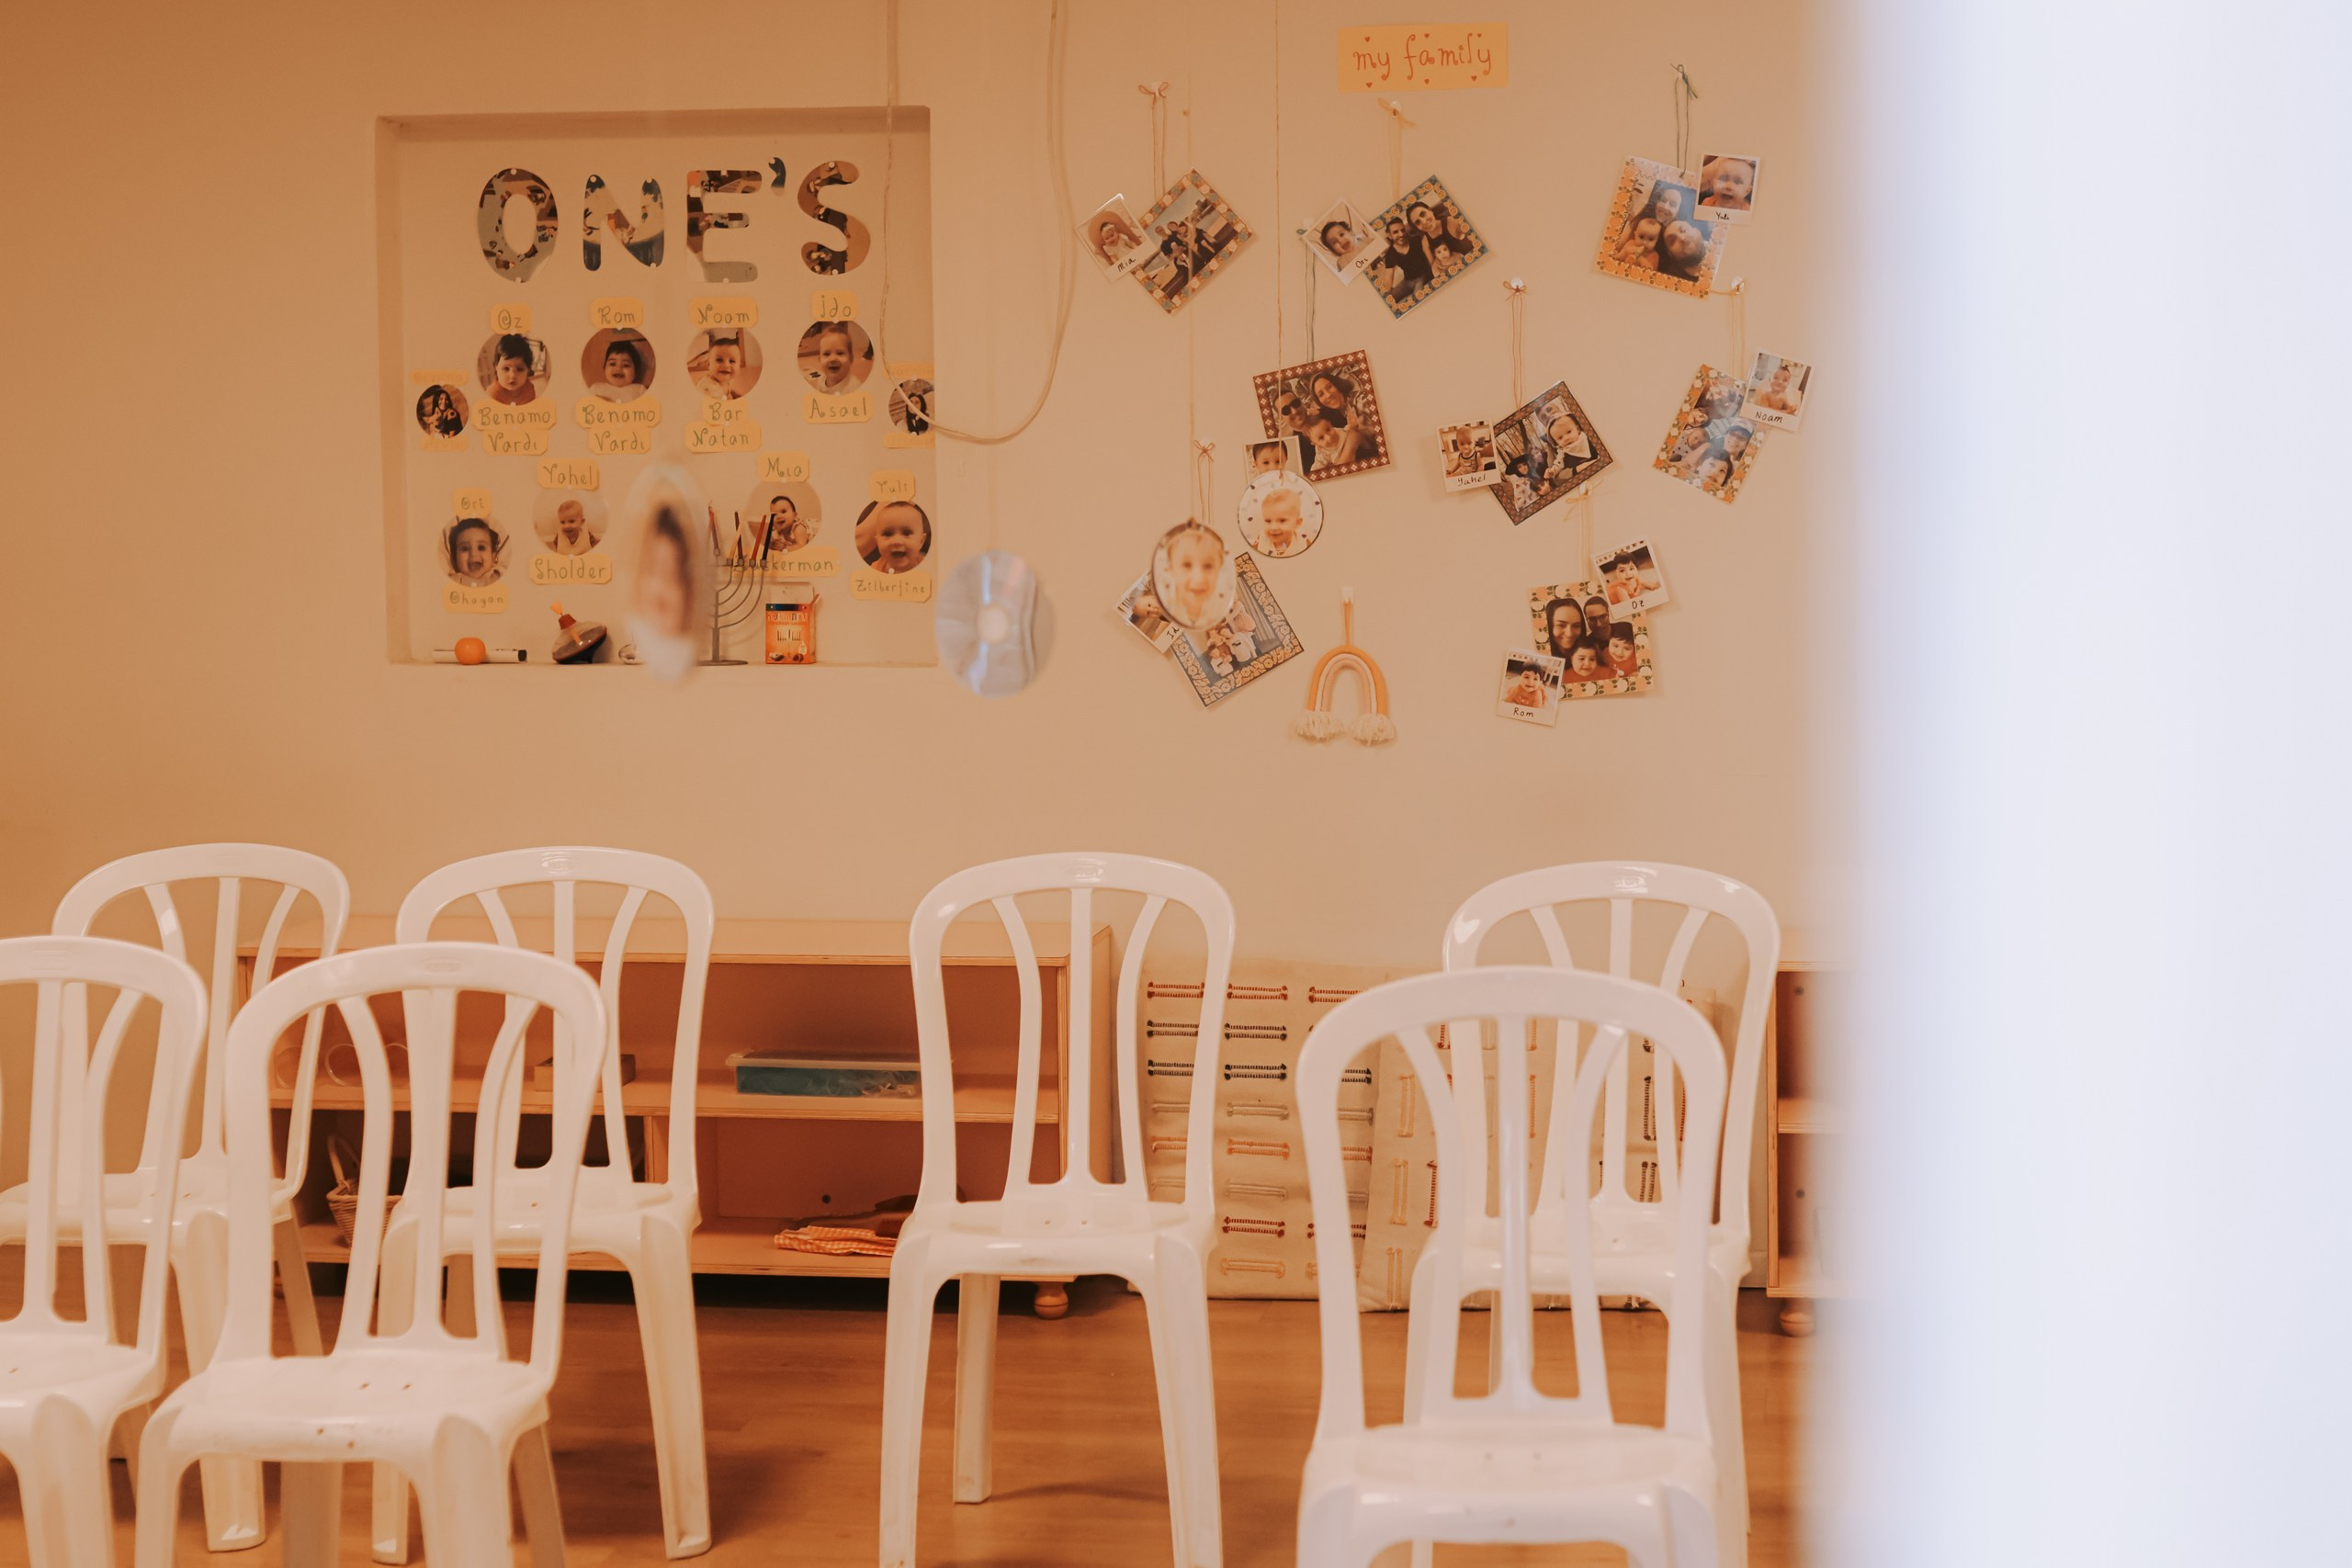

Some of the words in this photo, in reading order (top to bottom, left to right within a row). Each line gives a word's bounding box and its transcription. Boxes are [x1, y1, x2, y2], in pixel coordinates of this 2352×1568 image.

[1352, 51, 1391, 81] my
[1403, 32, 1491, 81] family
[477, 156, 871, 284] ONE'S
[1116, 257, 1136, 273] Mia
[497, 308, 524, 331] Oz
[597, 305, 636, 325] Rom
[696, 303, 751, 325] Noam
[477, 406, 551, 427] Benamo
[582, 404, 656, 425] Benamo
[708, 401, 743, 422] Bar
[808, 396, 868, 420] Asael
[1755, 411, 1783, 423] Noam
[487, 432, 538, 454] Vardi
[594, 430, 646, 452] Vardi
[691, 427, 750, 447] Natan
[543, 463, 594, 486] Yahel
[765, 457, 803, 478] Mia
[460, 496, 485, 511] Ori
[535, 557, 608, 581] Sholder
[1513, 706, 1534, 717] Rom
